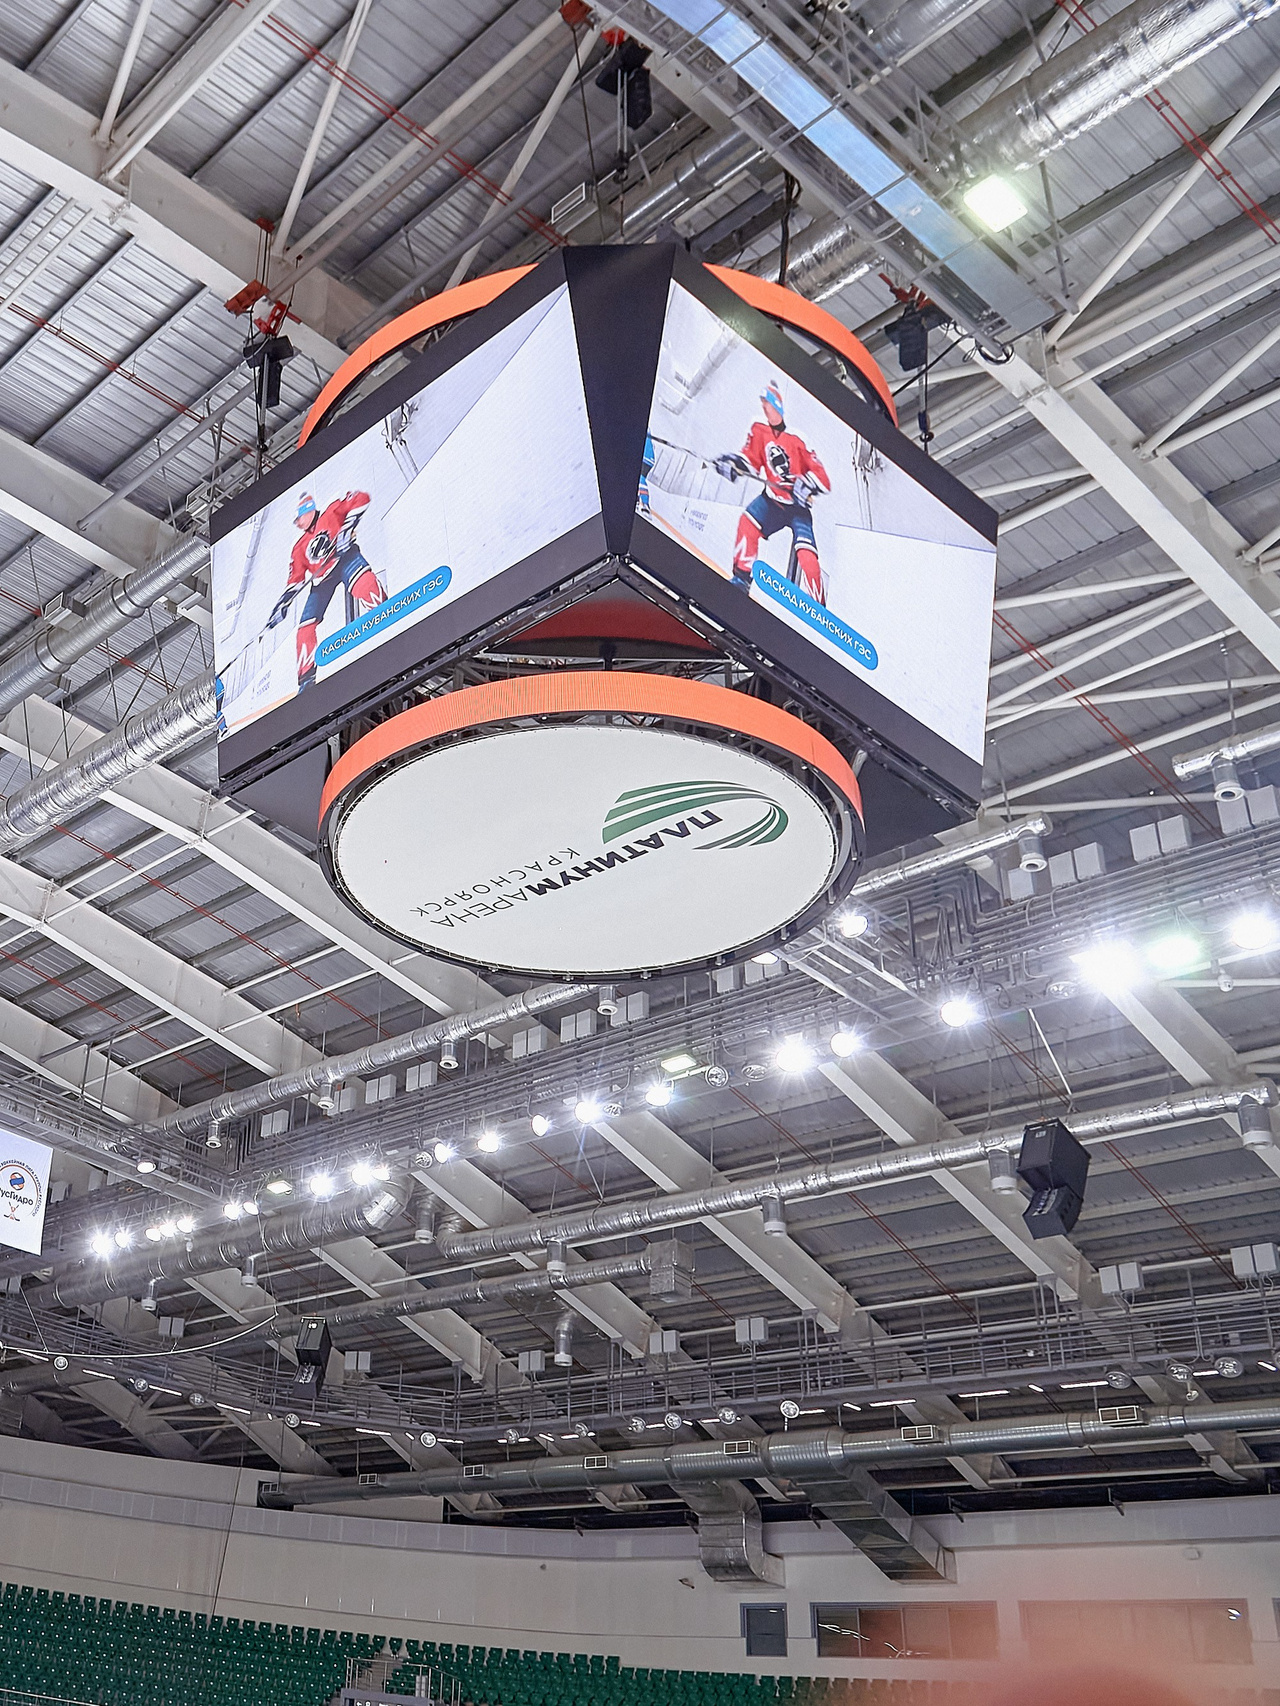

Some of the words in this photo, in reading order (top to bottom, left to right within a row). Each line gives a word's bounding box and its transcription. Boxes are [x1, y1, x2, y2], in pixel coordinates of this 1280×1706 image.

[321, 627, 361, 658] КАСКАД
[361, 589, 421, 633] КУБАНСКИХ
[422, 574, 445, 597] ГЭС
[759, 568, 798, 606] КАСКАД
[798, 600, 853, 645] КУБАНСКИХ
[853, 639, 873, 661] ГЭС
[409, 846, 582, 918] КРАСНОЯРСК
